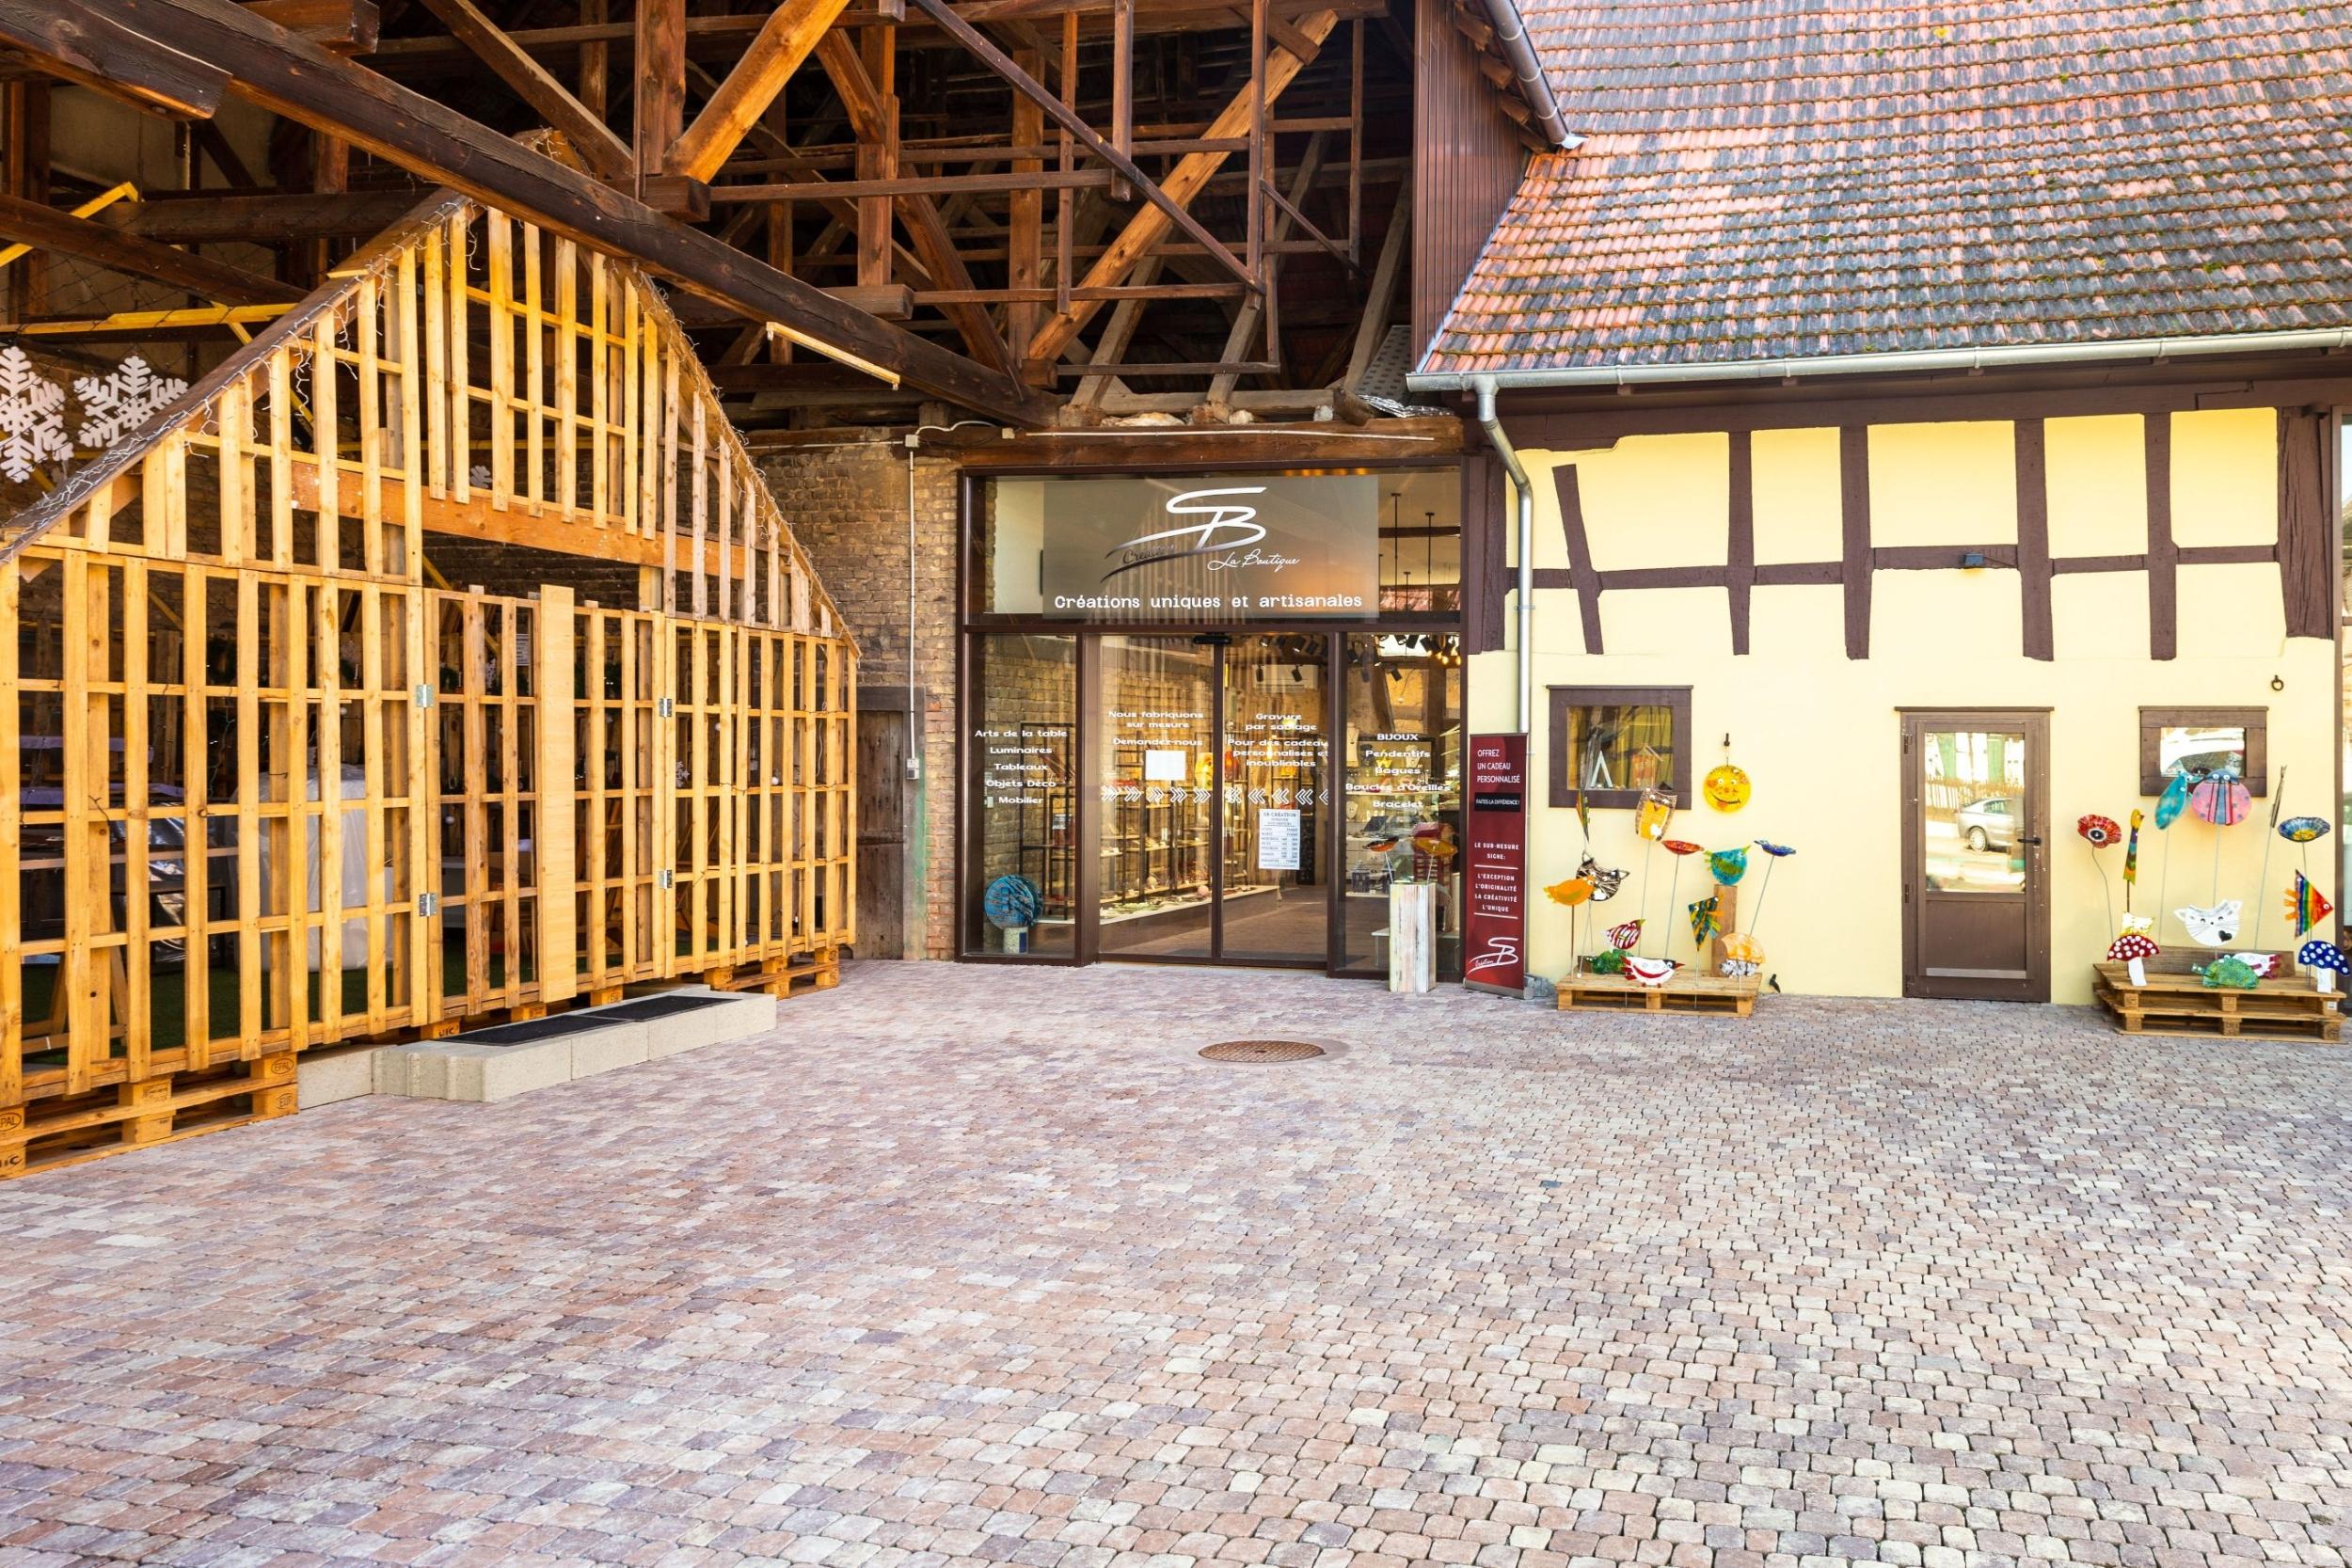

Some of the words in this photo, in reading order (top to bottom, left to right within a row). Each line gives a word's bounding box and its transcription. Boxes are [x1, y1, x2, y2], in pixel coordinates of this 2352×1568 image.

[1207, 551, 1241, 571] La
[1240, 548, 1301, 573] Boutique
[1055, 594, 1140, 609] Créations
[1151, 594, 1220, 610] uniques
[1232, 595, 1249, 608] et
[1259, 594, 1362, 608] artisanales
[1141, 711, 1204, 720] fabriquons
[1270, 722, 1317, 732] sabage
[990, 746, 1053, 754] Luminaires
[1232, 749, 1314, 757] personalisés
[1365, 750, 1431, 758] Pendentifs
[1477, 749, 1500, 757] OFFREZ
[1246, 759, 1316, 768] inoubliables
[1375, 767, 1422, 775] Bagues
[1476, 773, 1520, 784] PERSONNALISÉ
[986, 780, 1023, 788] Objets
[1026, 779, 1057, 787] Déco
[1345, 783, 1392, 791] Boucles
[1397, 784, 1451, 792] d'Oreilles
[998, 796, 1044, 804] Mobilier
[1477, 873, 1515, 881] L'EXCEPTION
[1475, 883, 1517, 892] L'ORIGINALITÉ
[1484, 894, 1518, 903] CRÉATIVITÉ
[1482, 904, 1509, 912] L'UNIQUE
